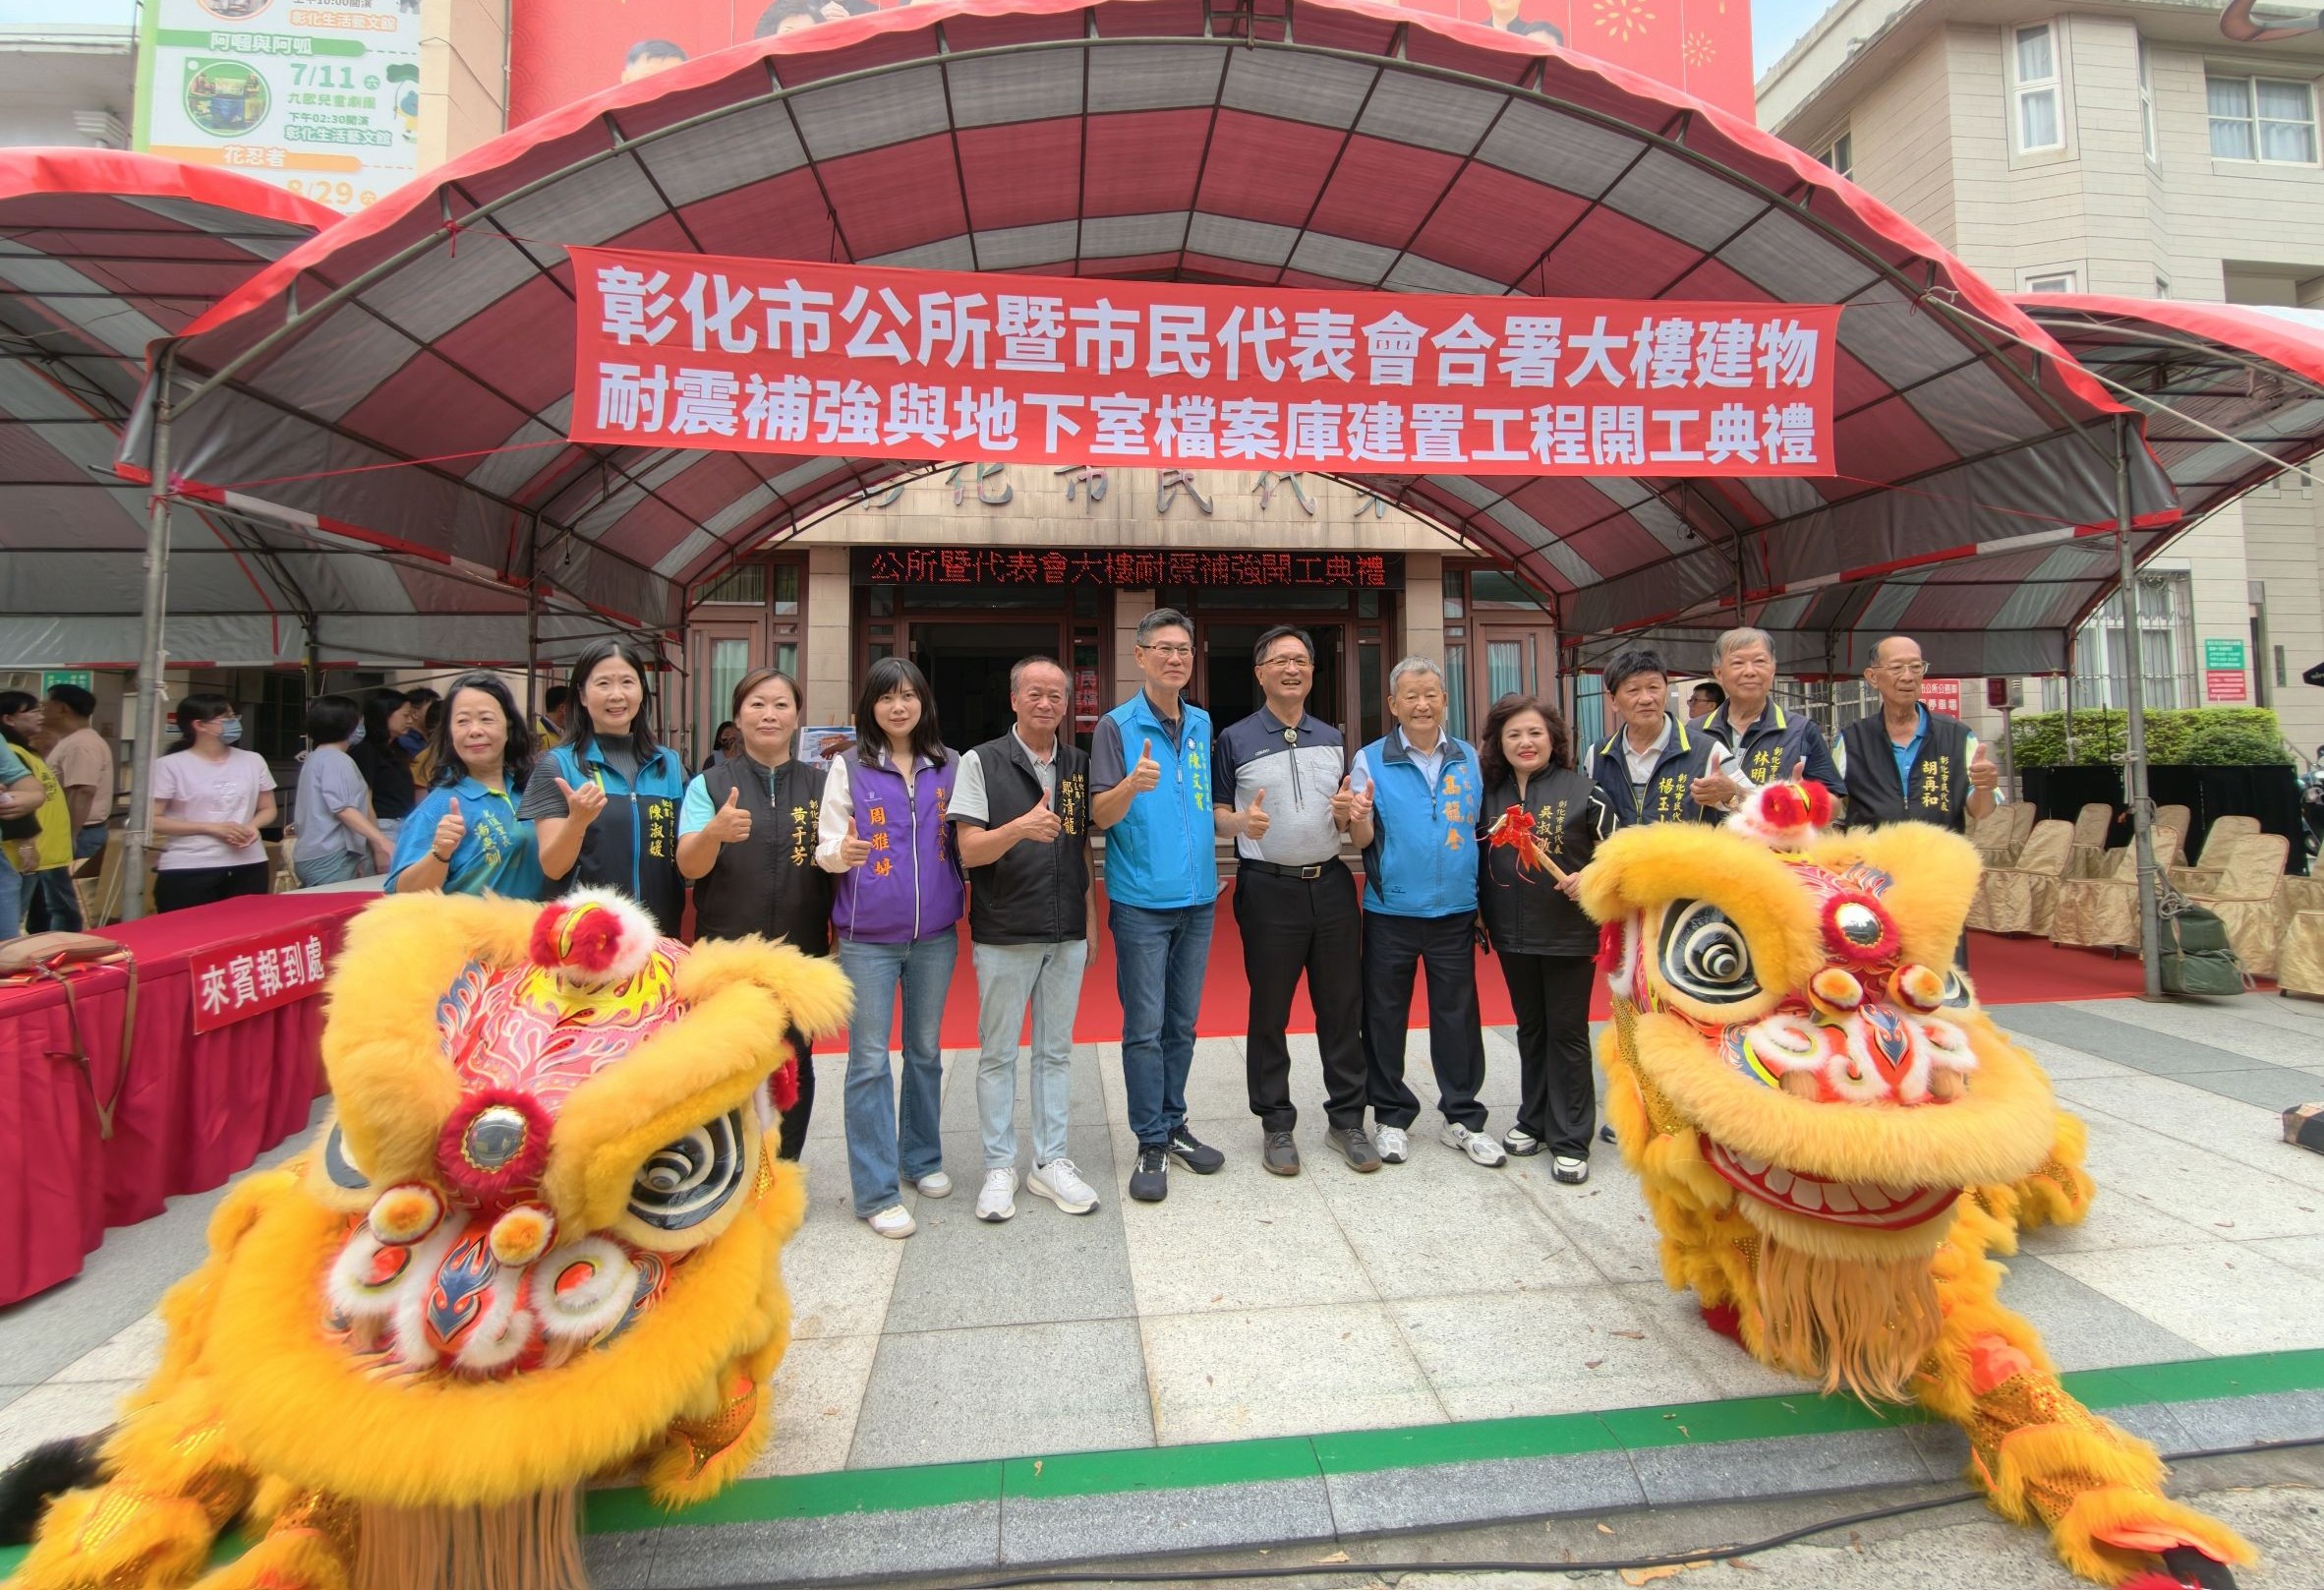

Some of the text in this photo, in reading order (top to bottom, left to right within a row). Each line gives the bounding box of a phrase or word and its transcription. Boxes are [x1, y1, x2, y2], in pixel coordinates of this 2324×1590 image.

[291, 9, 396, 31] 彰化生活藝文館
[290, 63, 380, 89] 7/11 六
[284, 125, 392, 147] 彰化生活藝文館
[289, 112, 370, 126] 下午02:30開演
[224, 145, 286, 167] 花忍者
[288, 179, 354, 206] 8/29
[596, 265, 1820, 390] 彰化市公所暨市民代表會合署大樓建物
[596, 362, 1819, 466] 耐震補強與地下室檔案庫建置工程開工典禮
[871, 548, 1386, 587] 公所暨代表會大樓耐震補強開工典禮
[1750, 750, 1771, 787] 林明
[1922, 760, 1939, 807] 胡再和
[1554, 799, 1568, 854] 彰化市民代表
[203, 934, 325, 1016] 來賓報到處
